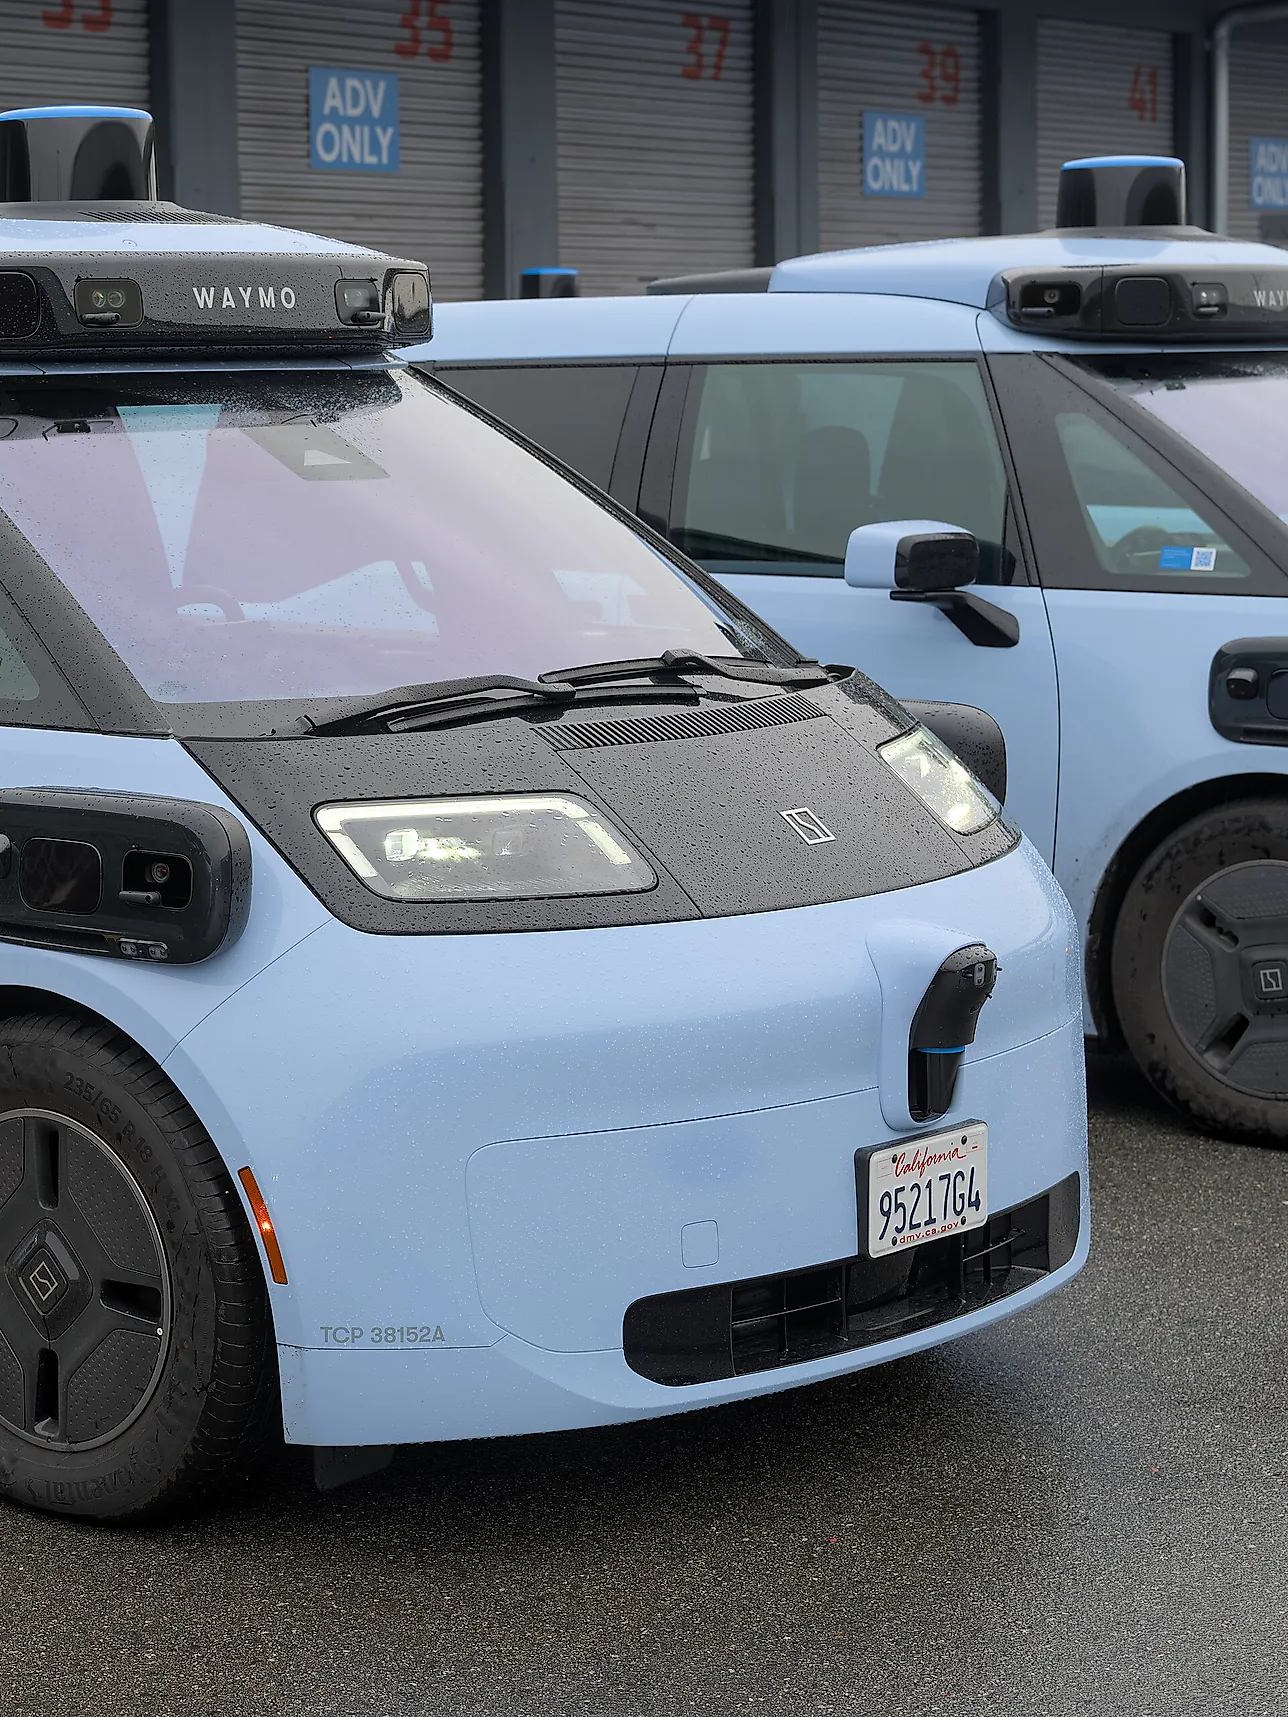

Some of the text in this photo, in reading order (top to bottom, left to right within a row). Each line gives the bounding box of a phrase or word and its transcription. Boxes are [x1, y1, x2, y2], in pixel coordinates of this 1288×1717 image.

[680, 13, 730, 81] 37
[916, 42, 959, 106] 39
[322, 77, 386, 118] ADV
[1128, 64, 1159, 123] 41
[315, 122, 394, 165] ONLY
[872, 118, 917, 154] ADV
[866, 156, 922, 192] ONLY
[1252, 176, 1288, 205] ONL
[192, 286, 296, 309] WAYMO
[1253, 290, 1288, 307] WAY
[63, 1071, 123, 1124] 235/65
[136, 1137, 153, 1164] 18
[894, 1142, 967, 1178] California
[878, 1166, 982, 1241] 95217G4
[899, 1221, 959, 1244] dmv.ca.gov
[320, 1325, 446, 1343] TCP 38152A
